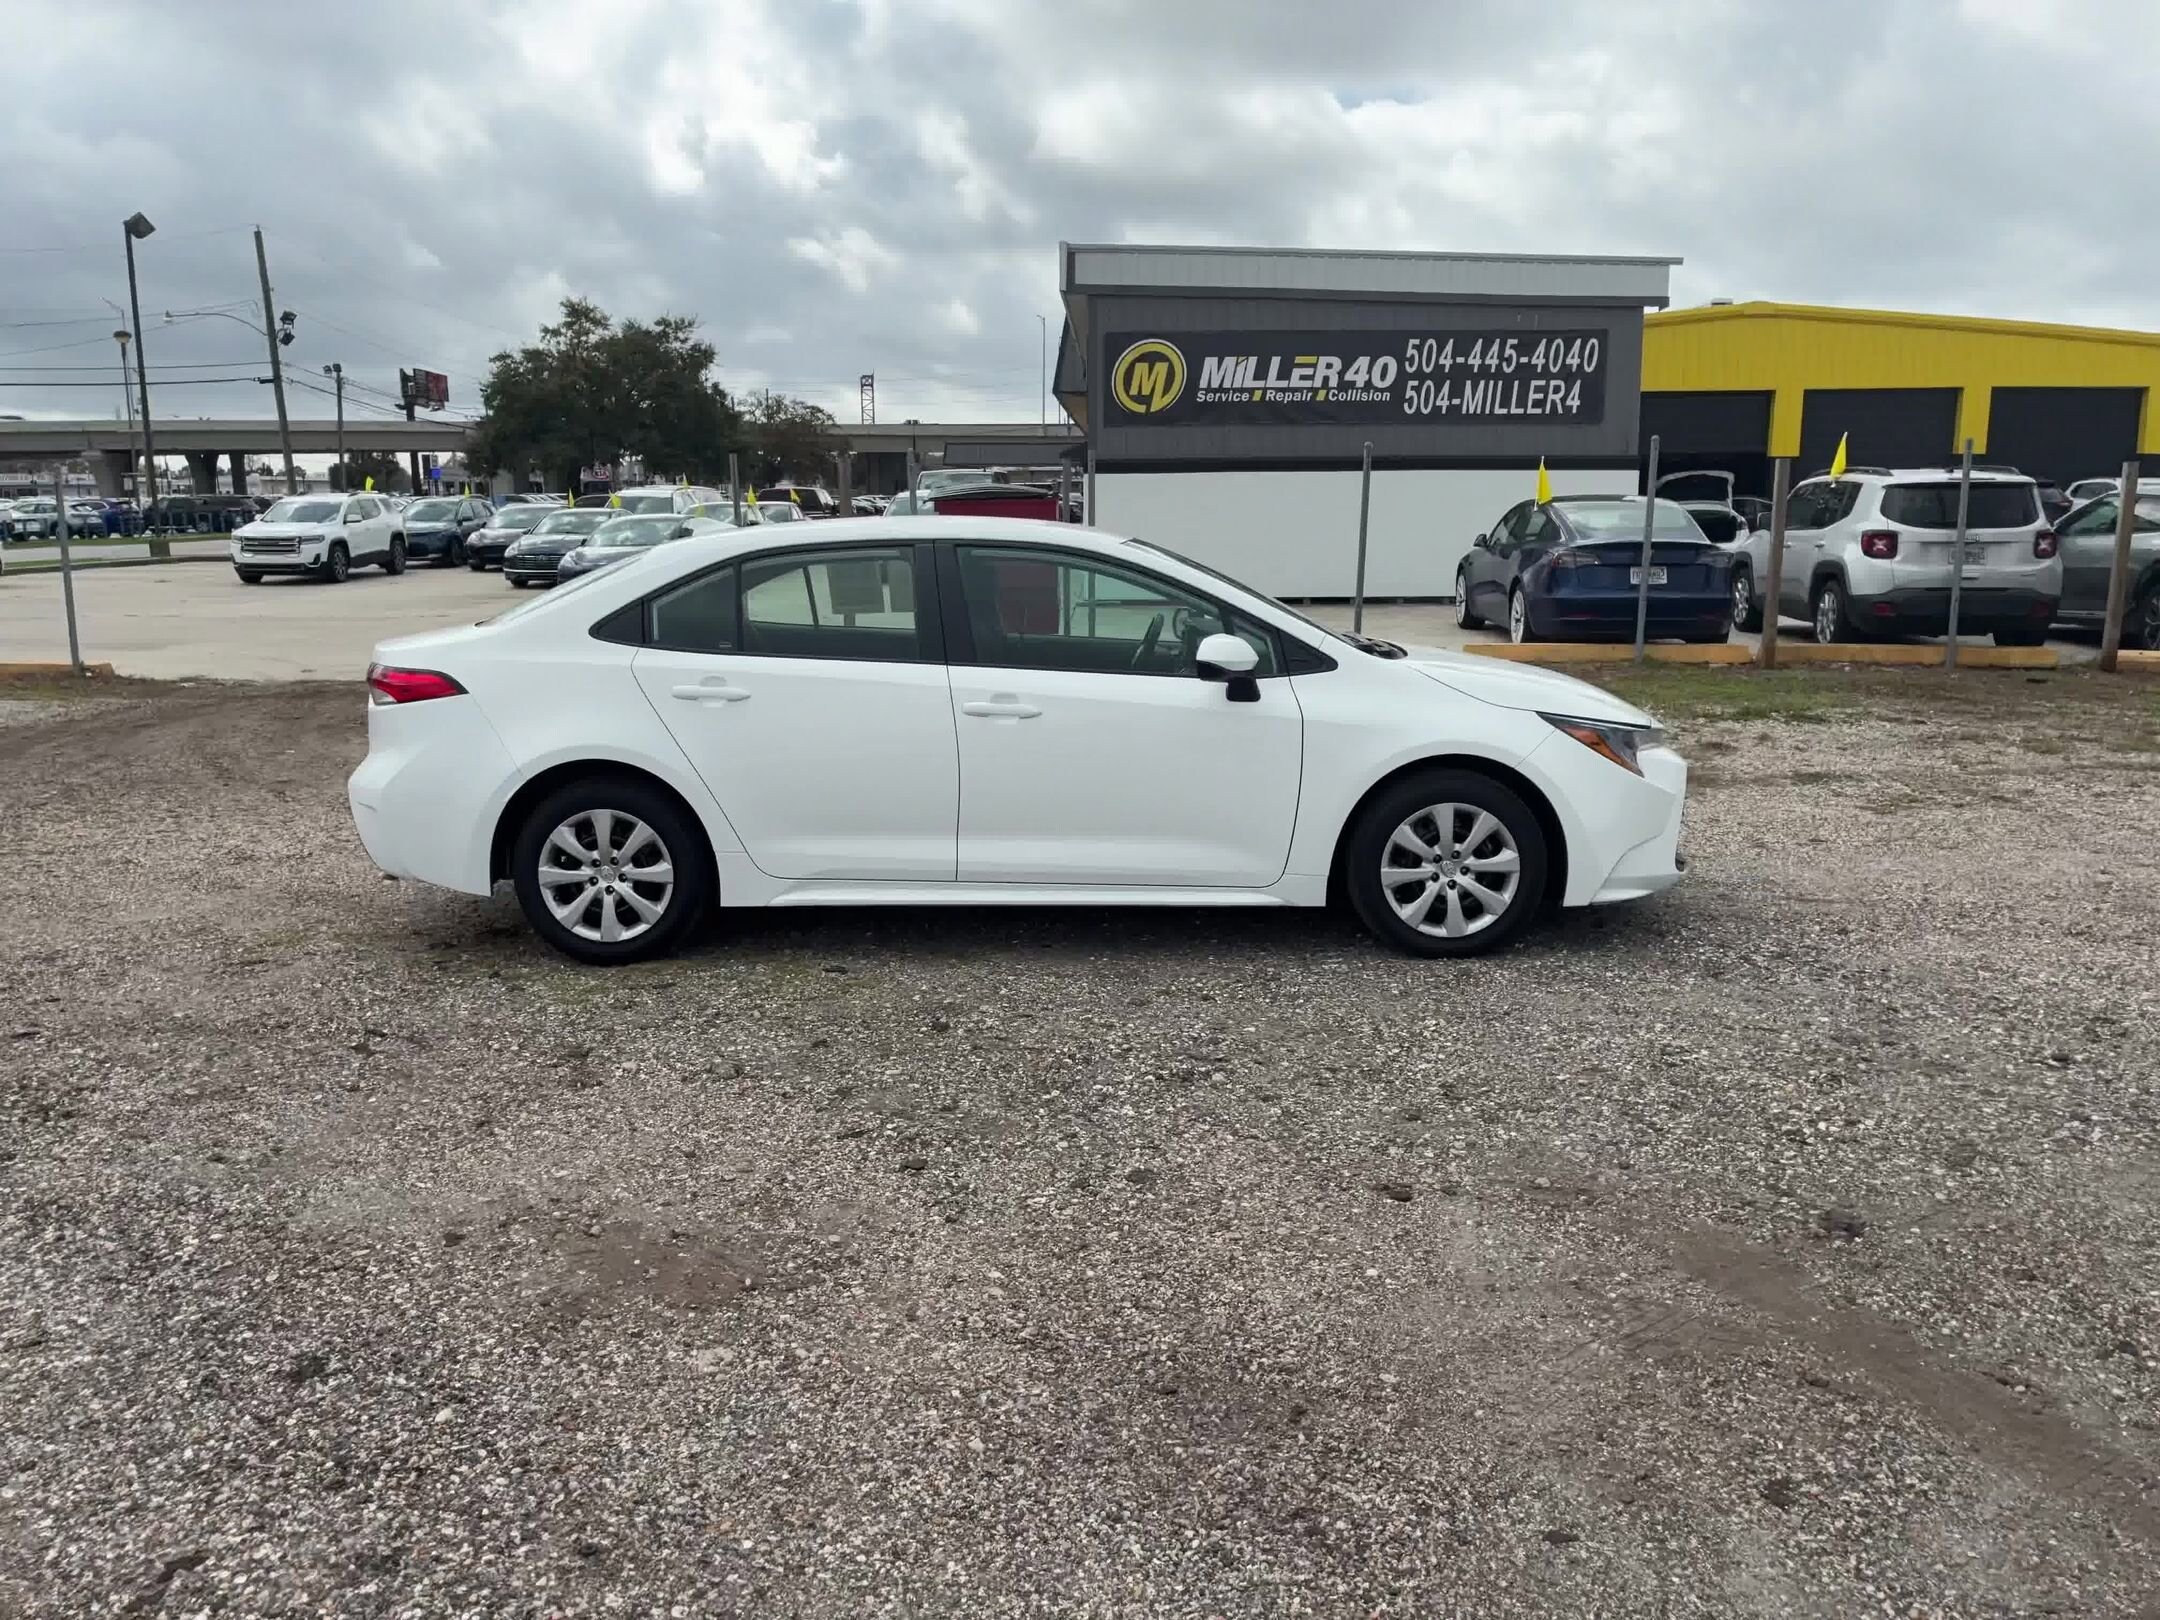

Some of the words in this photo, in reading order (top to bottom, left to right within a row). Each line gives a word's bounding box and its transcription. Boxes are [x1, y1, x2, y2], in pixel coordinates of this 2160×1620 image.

[1344, 355, 1398, 389] 40
[1404, 338, 1599, 373] 504-445-4040
[1196, 390, 1250, 402] Service
[1265, 389, 1313, 404] Repair
[1328, 389, 1391, 402] Collision
[1403, 379, 1581, 414] 504-MILLER4
